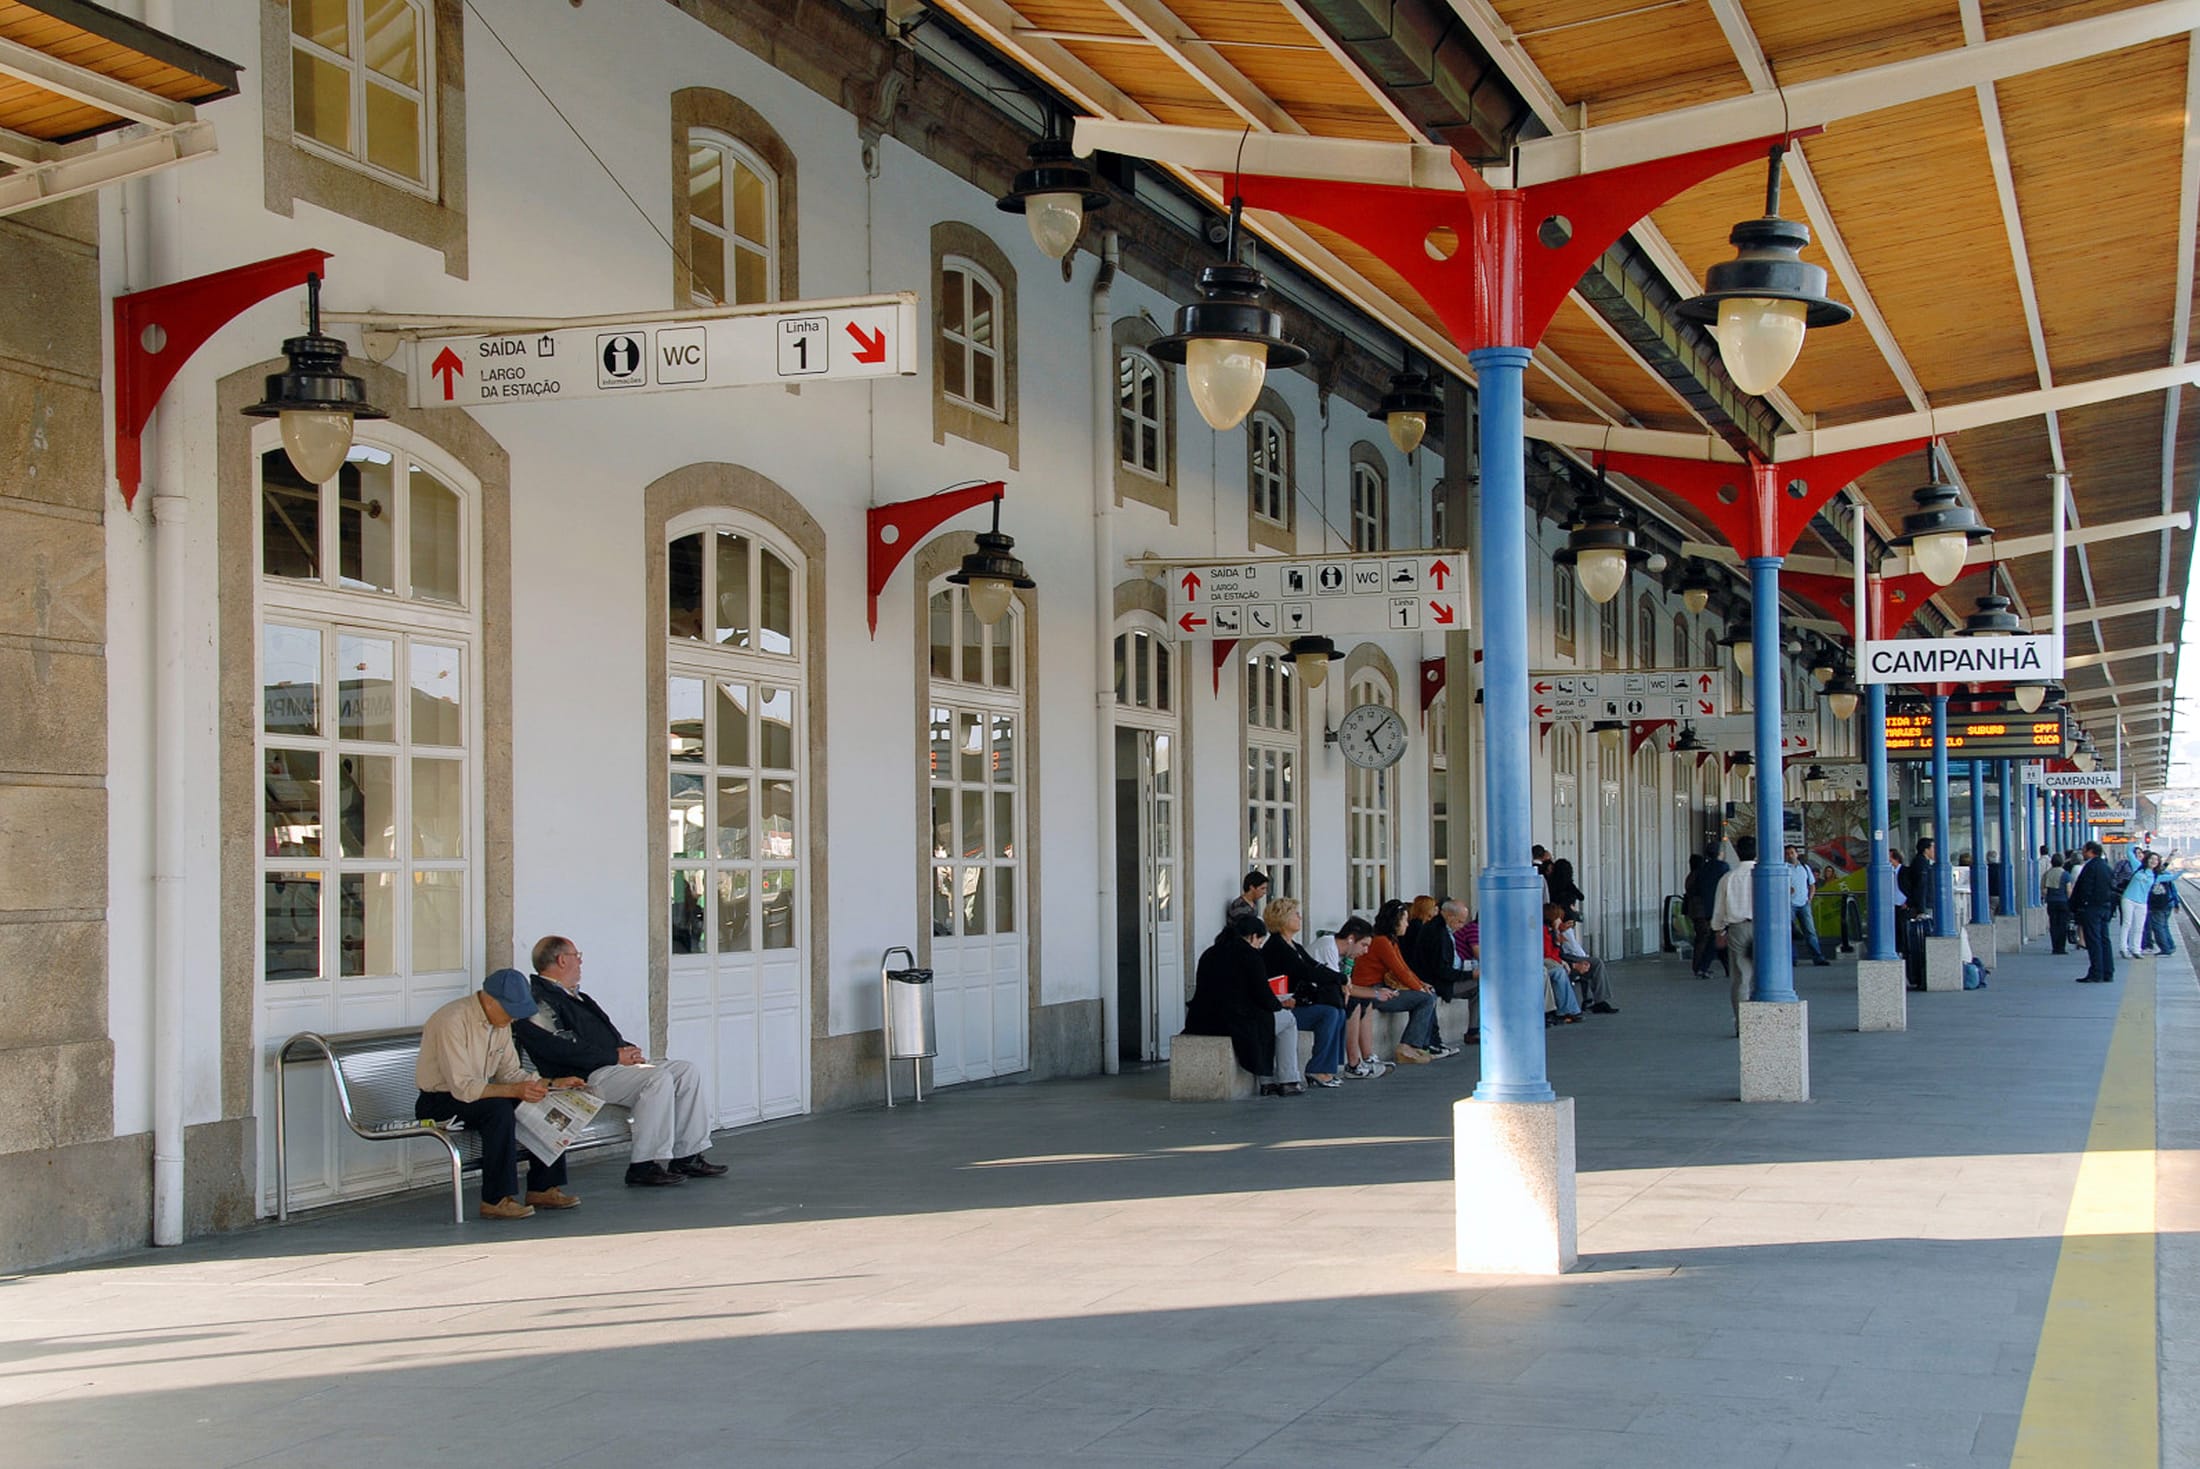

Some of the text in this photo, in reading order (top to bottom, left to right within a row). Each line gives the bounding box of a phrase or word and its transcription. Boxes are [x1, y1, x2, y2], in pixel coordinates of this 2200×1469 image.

[786, 321, 820, 333] Linha
[480, 338, 527, 357] SAÍDA
[793, 337, 807, 370] 1
[663, 345, 701, 367] WC
[481, 367, 526, 382] LARGO
[481, 379, 561, 398] DA ESTAÇÃO
[1210, 567, 1240, 579] SAÍDA
[1356, 571, 1379, 584] WC
[1398, 608, 1407, 626] 1
[1872, 641, 2041, 673] CAMPANHÃ
[1677, 704, 1684, 715] 1
[2045, 774, 2113, 786] CAMPANHÃ
